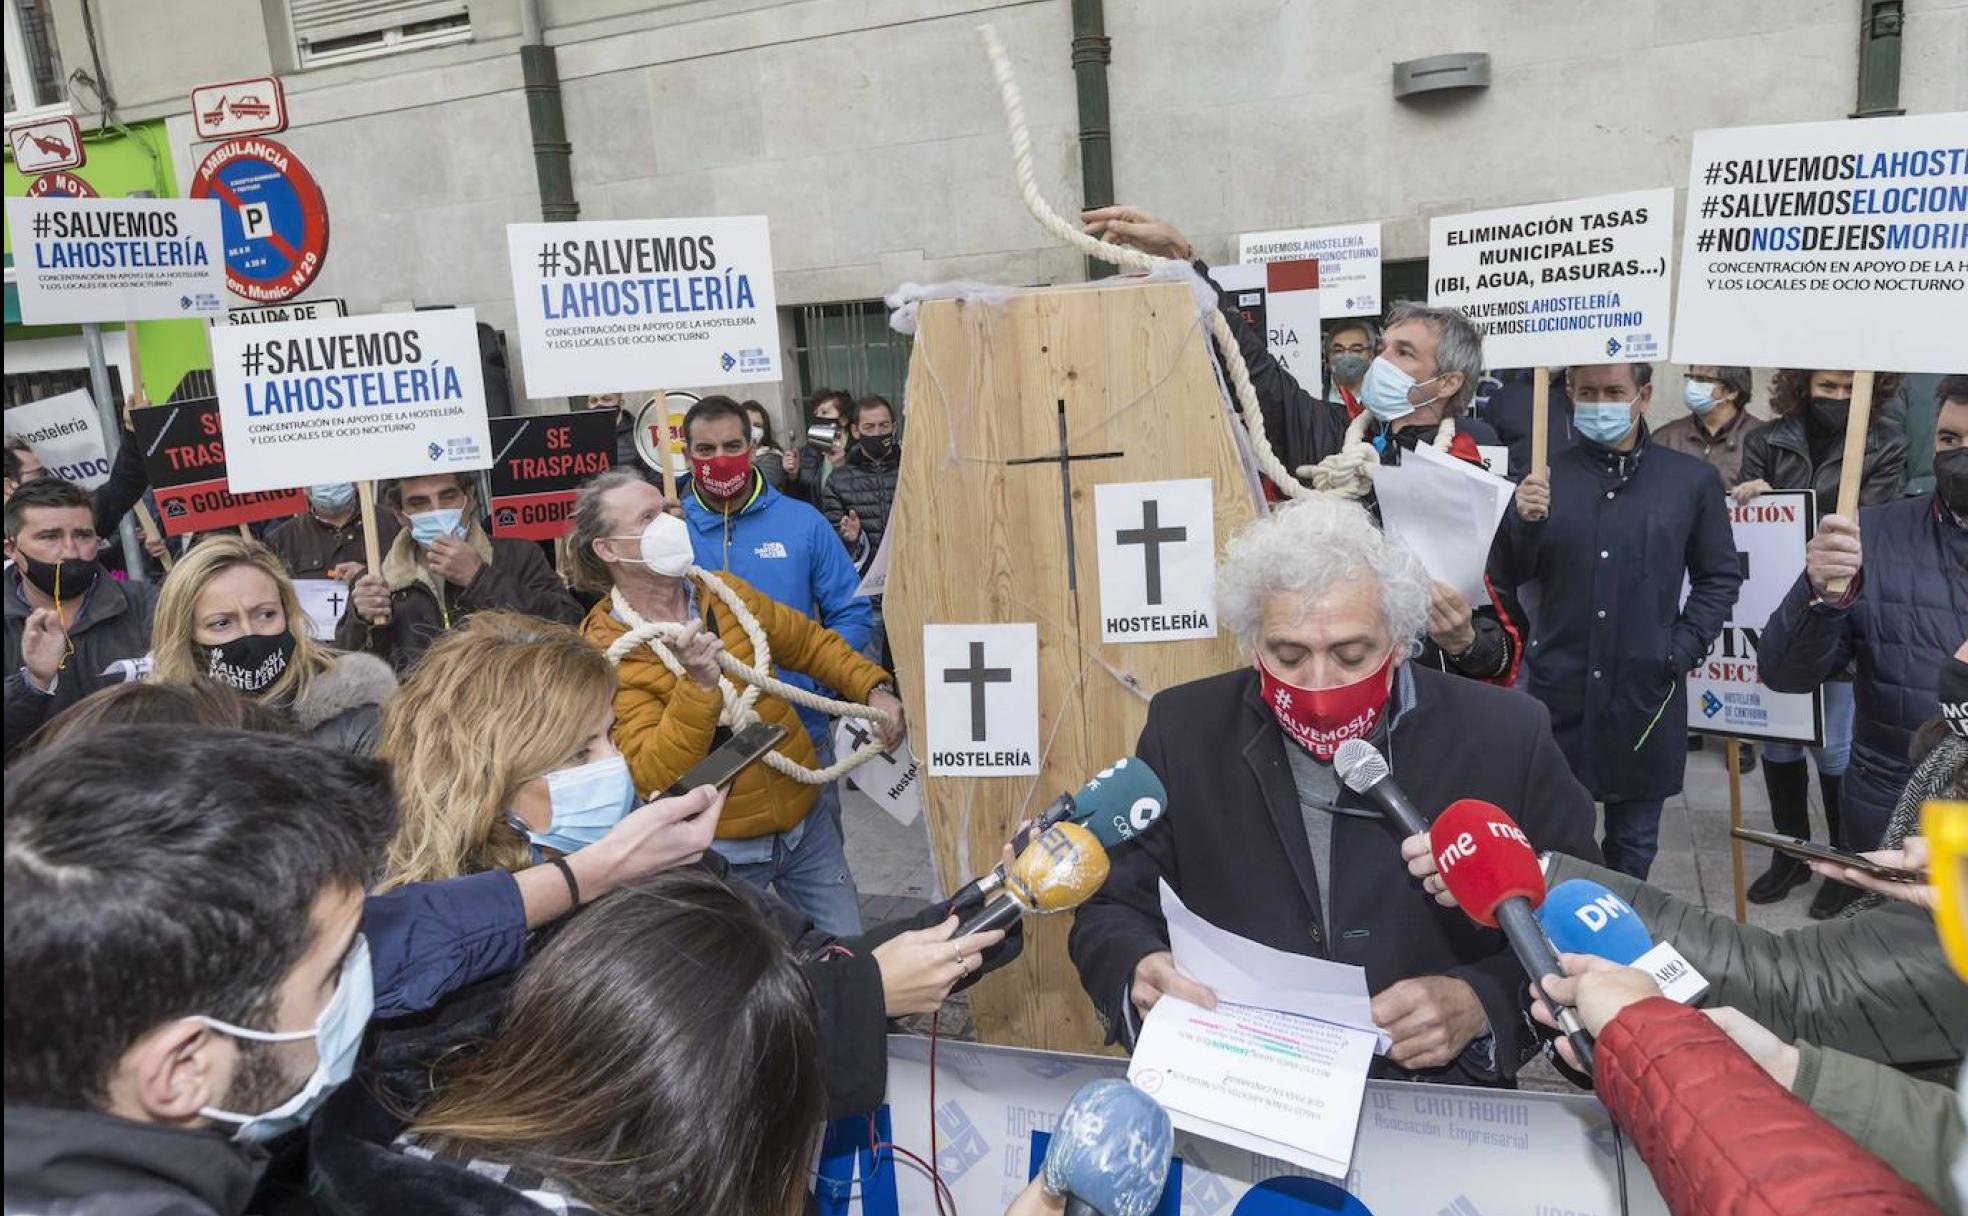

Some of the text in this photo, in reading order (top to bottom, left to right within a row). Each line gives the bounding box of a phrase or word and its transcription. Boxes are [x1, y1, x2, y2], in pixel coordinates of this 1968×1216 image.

[201, 141, 288, 180] AMBULANCIA
[33, 211, 178, 238] #SALVEMOS
[246, 209, 263, 233] P
[1447, 208, 1648, 246] ELIMINACIÓN TASAS
[35, 236, 208, 268] LAHOSTELERÍA
[538, 234, 716, 278] #SALVEMOS
[1480, 237, 1614, 266] MUNICIPALES
[1435, 256, 1666, 296] (IBI, AGUA, BASURAS...)
[1708, 260, 1827, 273] CONCENTRACIÓN
[1830, 261, 1850, 273] EN
[1852, 260, 1906, 274] APOYO
[1910, 260, 1932, 273] DE
[1934, 260, 1954, 273] LA
[249, 286, 292, 300] Munic.
[542, 266, 755, 320] LAHOSTELERÍA
[1706, 278, 1964, 290] Y LOS LOCALES DE OCIO NOCTURNO
[229, 306, 317, 326] SALIDA DE
[628, 324, 640, 332] EN
[642, 322, 674, 331] APOYO
[676, 321, 688, 330] DE
[690, 320, 700, 328] LA
[242, 329, 422, 377] #SALVEMOS
[547, 341, 553, 350] Y
[555, 340, 574, 348] LOS
[576, 337, 616, 348] LOCALES
[618, 337, 630, 345] DE
[657, 332, 710, 342] NOCTURNO
[245, 360, 462, 416] LAHOSTELERÍA
[332, 416, 344, 425] EN
[348, 414, 378, 424] APOYO
[380, 412, 394, 422] DE
[396, 411, 408, 420] LA
[258, 435, 276, 444] LOS
[278, 431, 320, 442] LOCALES
[322, 430, 333, 438] DE
[362, 422, 416, 435] NOCTURNO
[546, 427, 572, 450] SE
[164, 441, 225, 470] TRAS
[509, 451, 610, 480] TRASPASA
[1106, 612, 1210, 634] HOSTELERÍA
[1275, 688, 1293, 710] #
[932, 748, 1032, 768] HOSTELERÍA
[1487, 820, 1532, 848] rne
[1438, 832, 1478, 874] rne
[1575, 894, 1632, 932] DM
[1372, 1091, 1398, 1110] DE
